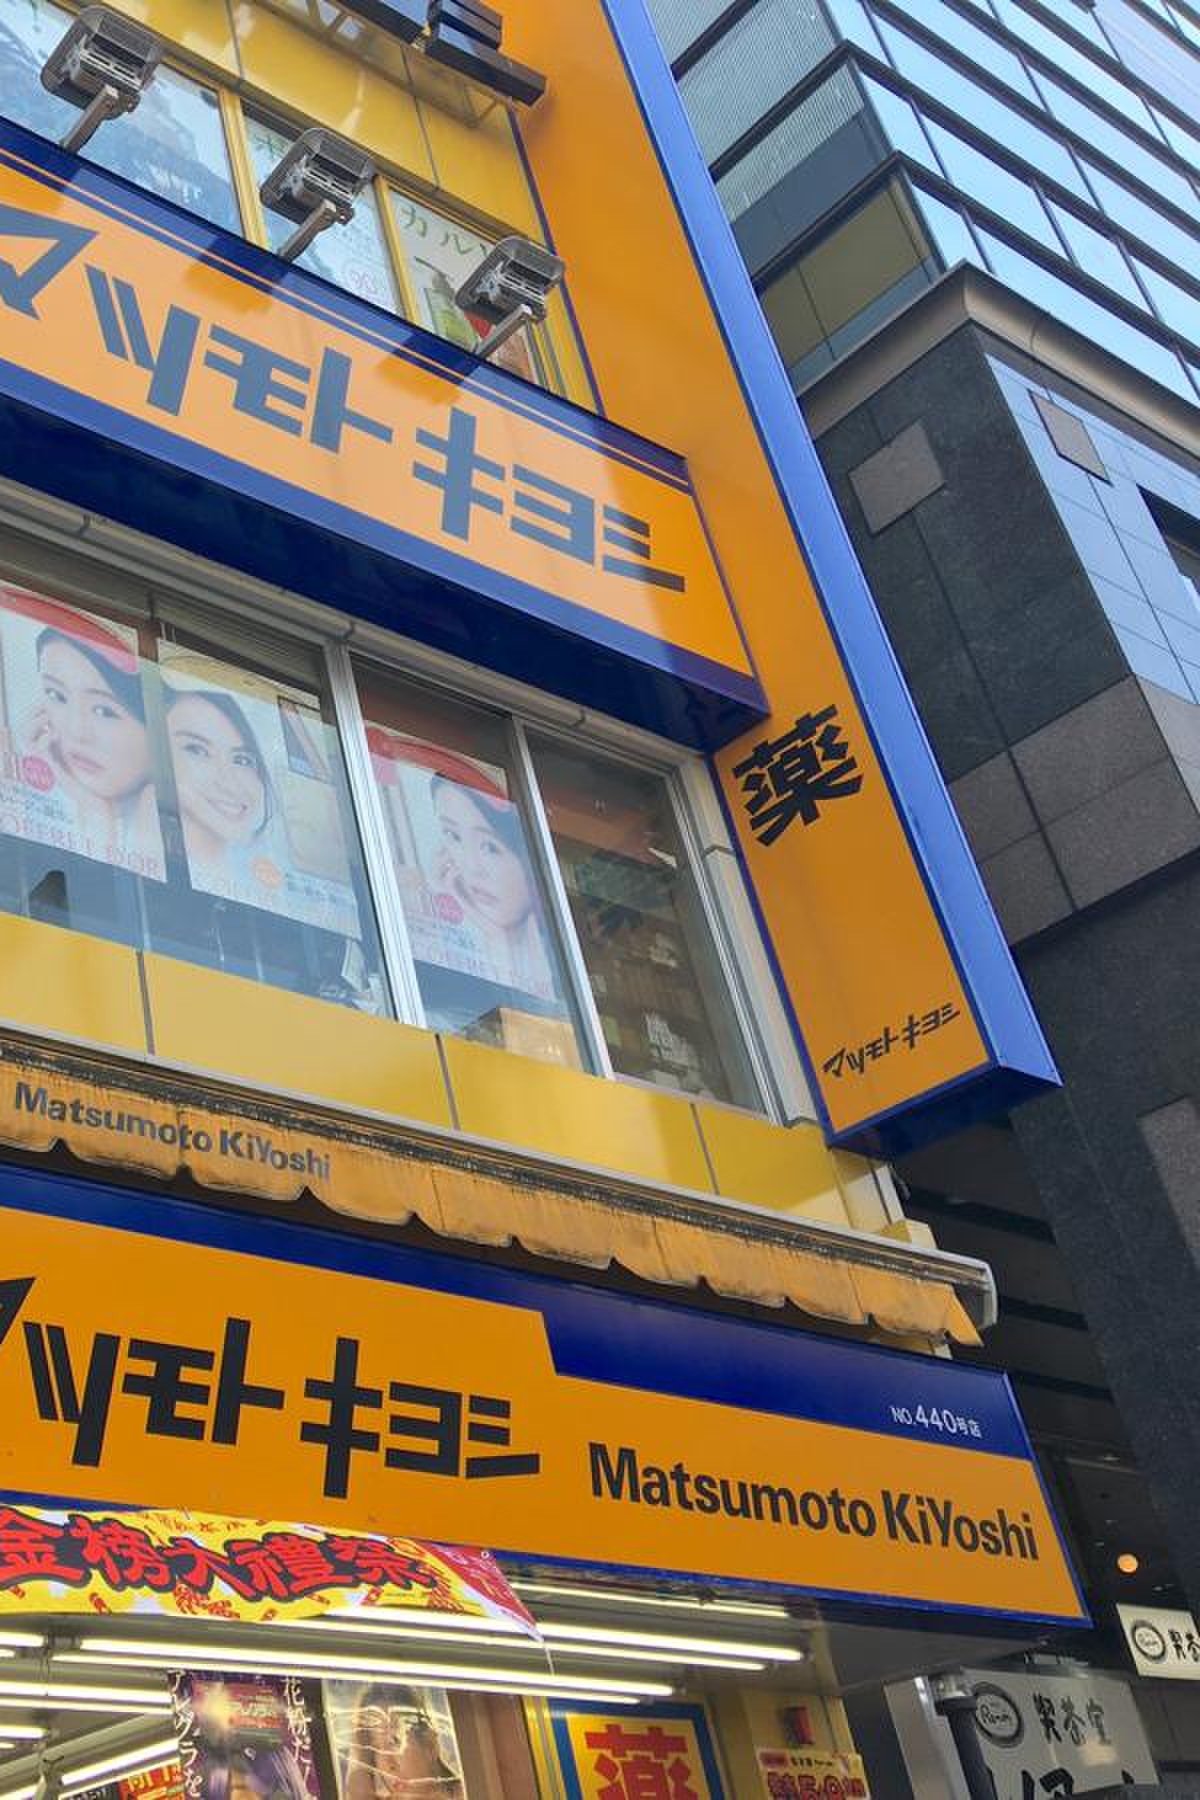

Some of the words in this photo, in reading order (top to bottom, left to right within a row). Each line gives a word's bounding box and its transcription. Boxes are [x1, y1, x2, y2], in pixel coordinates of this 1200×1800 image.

[732, 704, 864, 846] 薬
[821, 1002, 961, 1078] マツモトキヨシ
[14, 1081, 213, 1154] Matsumoto
[219, 1128, 331, 1182] KiYoshi
[588, 1442, 877, 1538] Matsumoto
[881, 1489, 1040, 1561] KiYoshi
